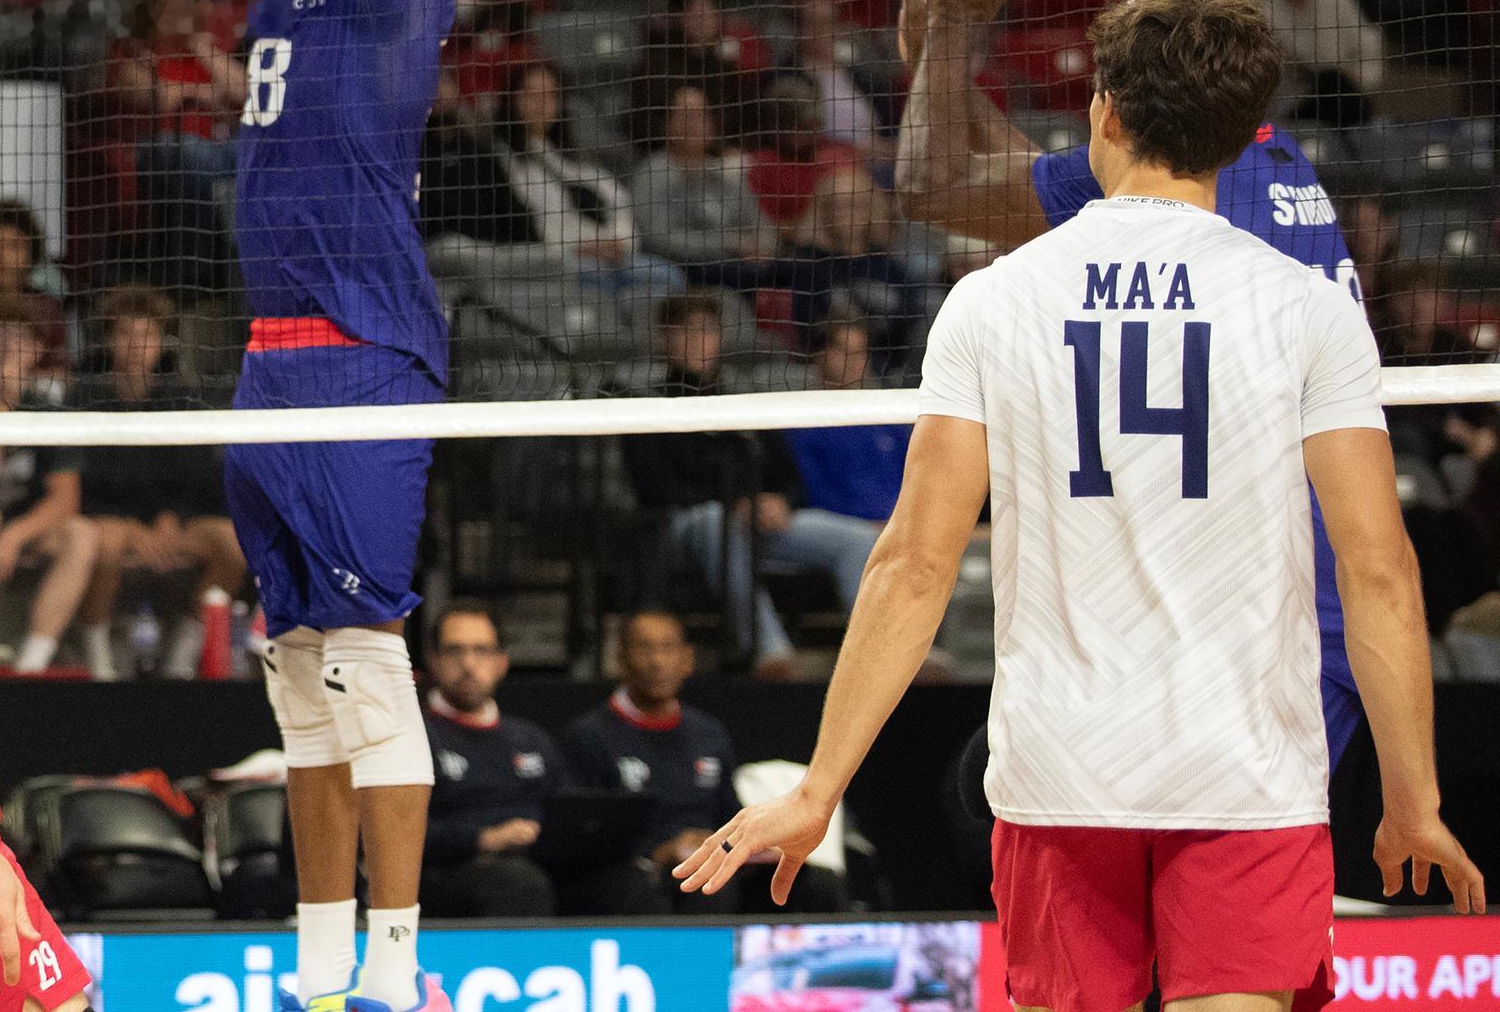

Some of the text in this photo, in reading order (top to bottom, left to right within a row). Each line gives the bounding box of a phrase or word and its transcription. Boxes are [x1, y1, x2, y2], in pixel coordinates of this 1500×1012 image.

[1082, 261, 1196, 310] MA'A
[1063, 319, 1212, 500] 14
[29, 940, 62, 991] 29
[1428, 954, 1500, 999] AP
